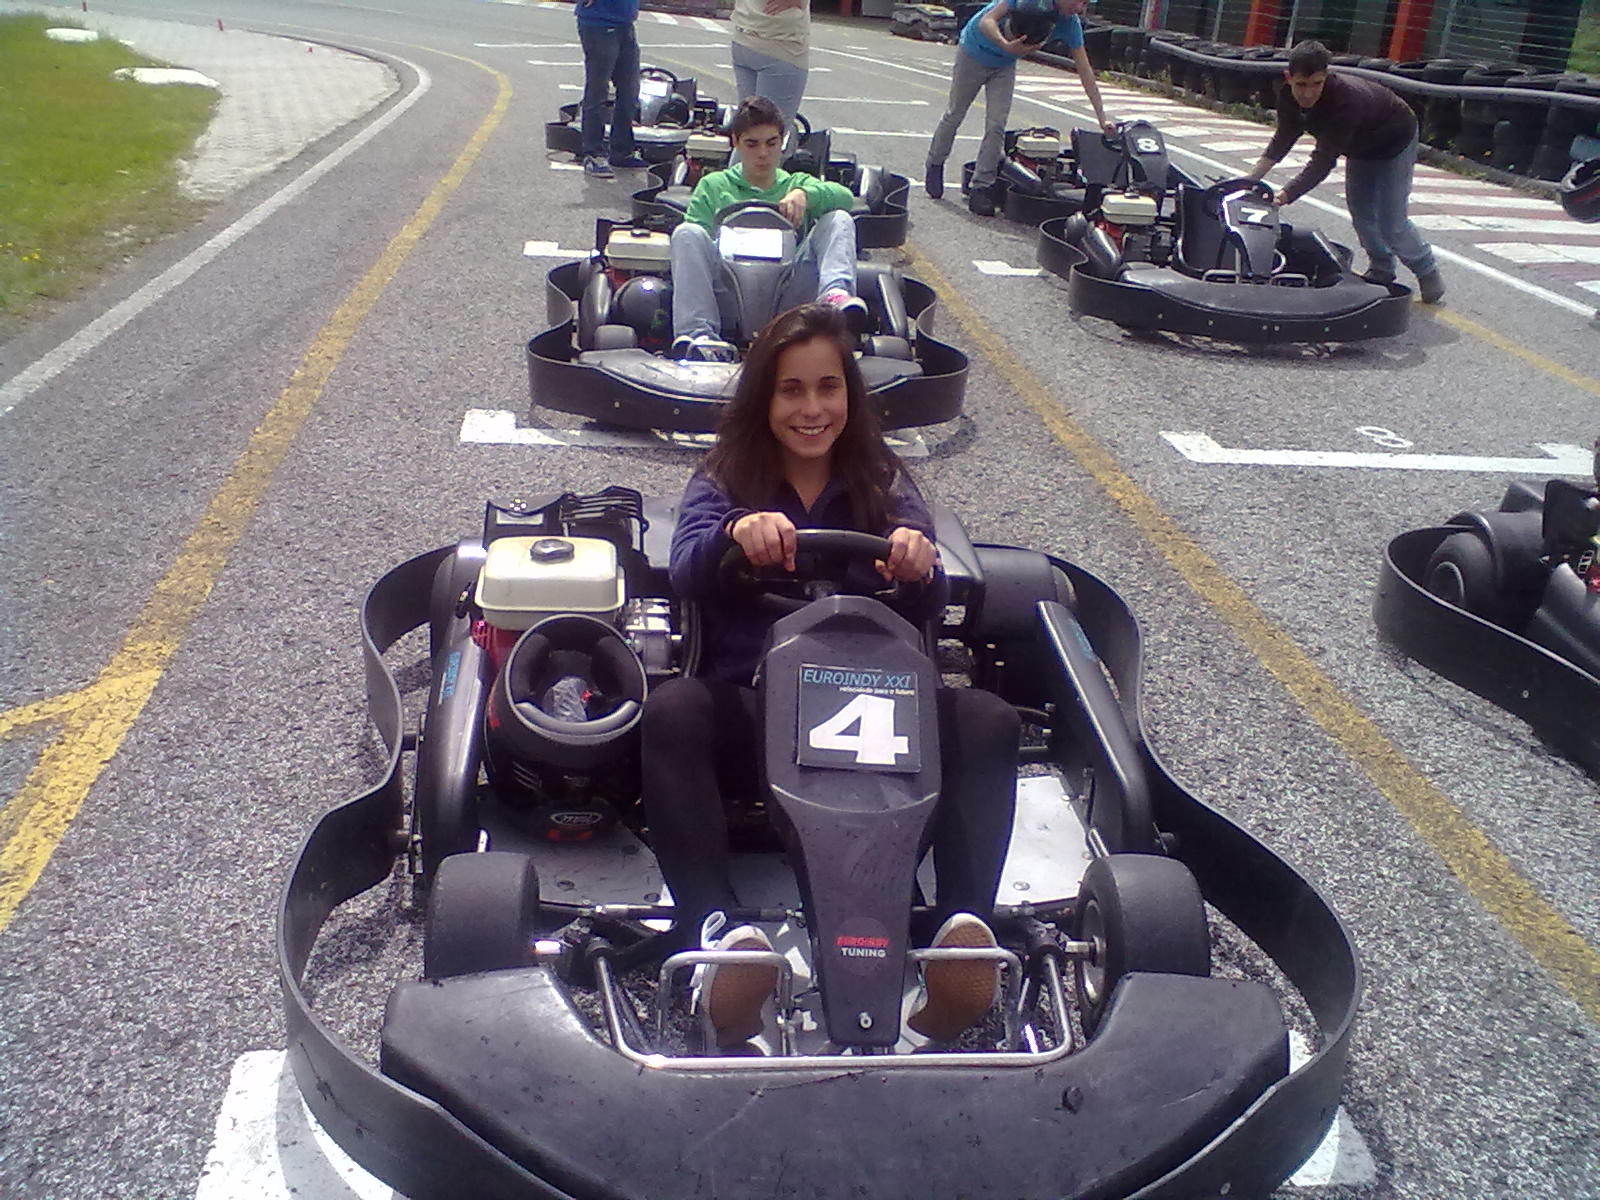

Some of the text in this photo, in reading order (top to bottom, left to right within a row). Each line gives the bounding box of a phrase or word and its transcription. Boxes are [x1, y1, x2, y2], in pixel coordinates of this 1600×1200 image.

[1137, 138, 1159, 152] 8
[1241, 207, 1269, 222] 7
[803, 669, 911, 689] EUROINDY XXI
[809, 693, 909, 765] 4
[841, 947, 886, 958] TUNING
